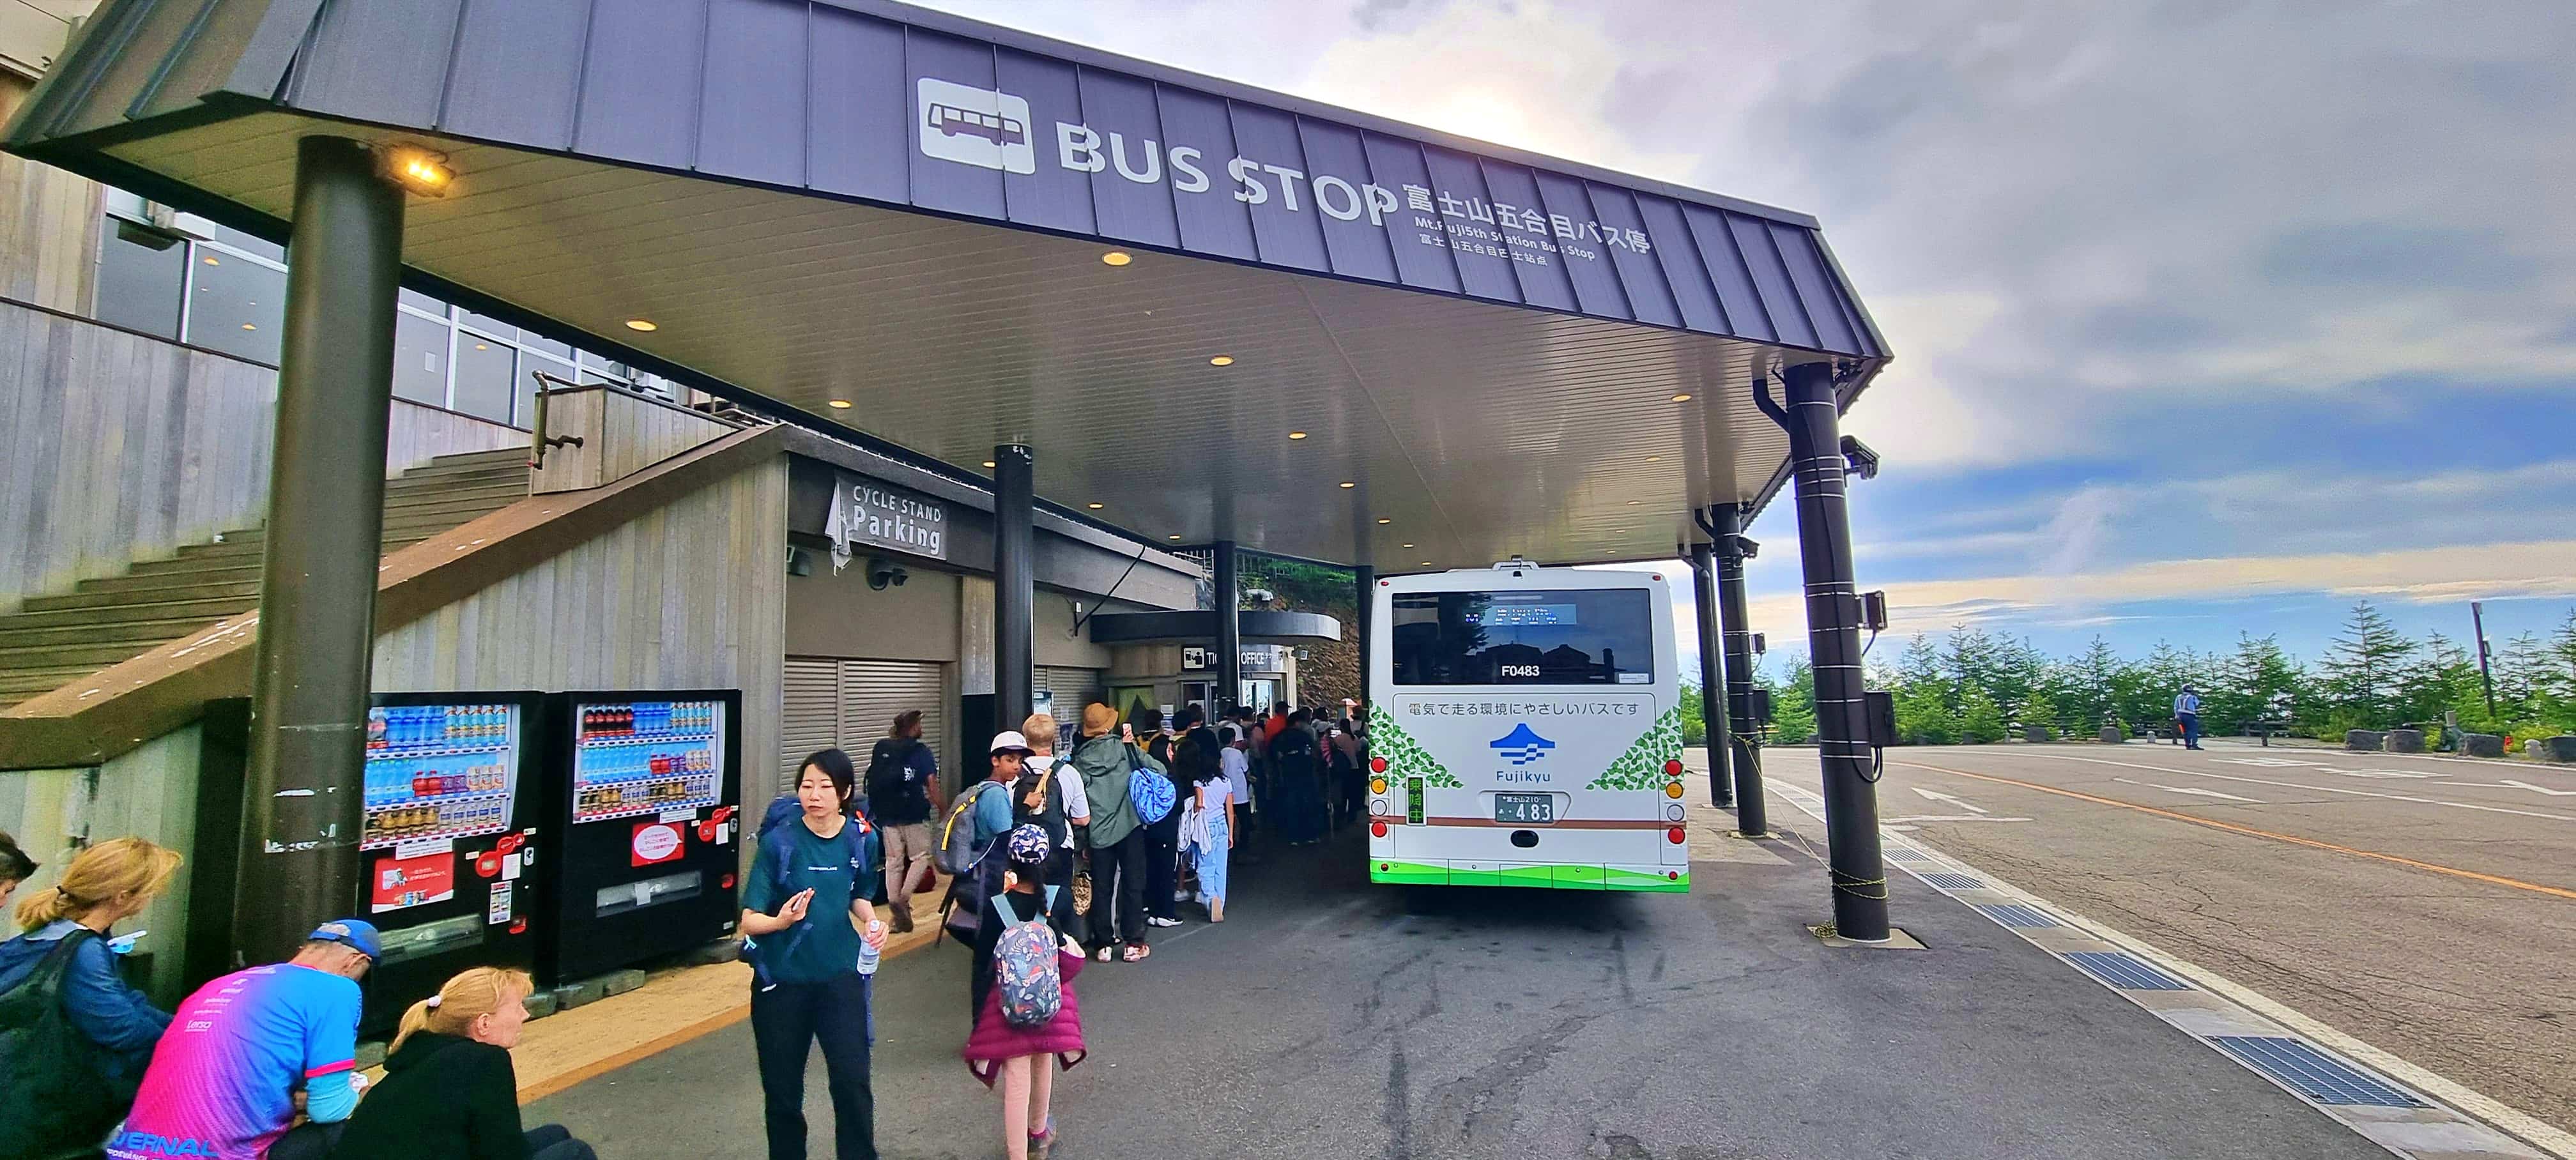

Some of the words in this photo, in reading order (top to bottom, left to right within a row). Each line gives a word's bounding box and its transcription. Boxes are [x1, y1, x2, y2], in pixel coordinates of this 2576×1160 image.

[1055, 121, 1211, 193] BUS
[1227, 155, 1399, 227] STOP
[1402, 183, 1651, 254] 富士山五合目バス停
[1490, 231, 1538, 249] Station
[1567, 245, 1595, 261] Stop
[853, 485, 896, 511] CYCLE
[901, 499, 942, 523] STAND
[853, 505, 941, 556] Parking
[1241, 652, 1264, 665] OFFICE
[1501, 666, 1540, 676] F0483
[1408, 702, 1639, 716] 電気で走る環境にやさしいバスです
[1496, 770, 1551, 783] Fujikyu
